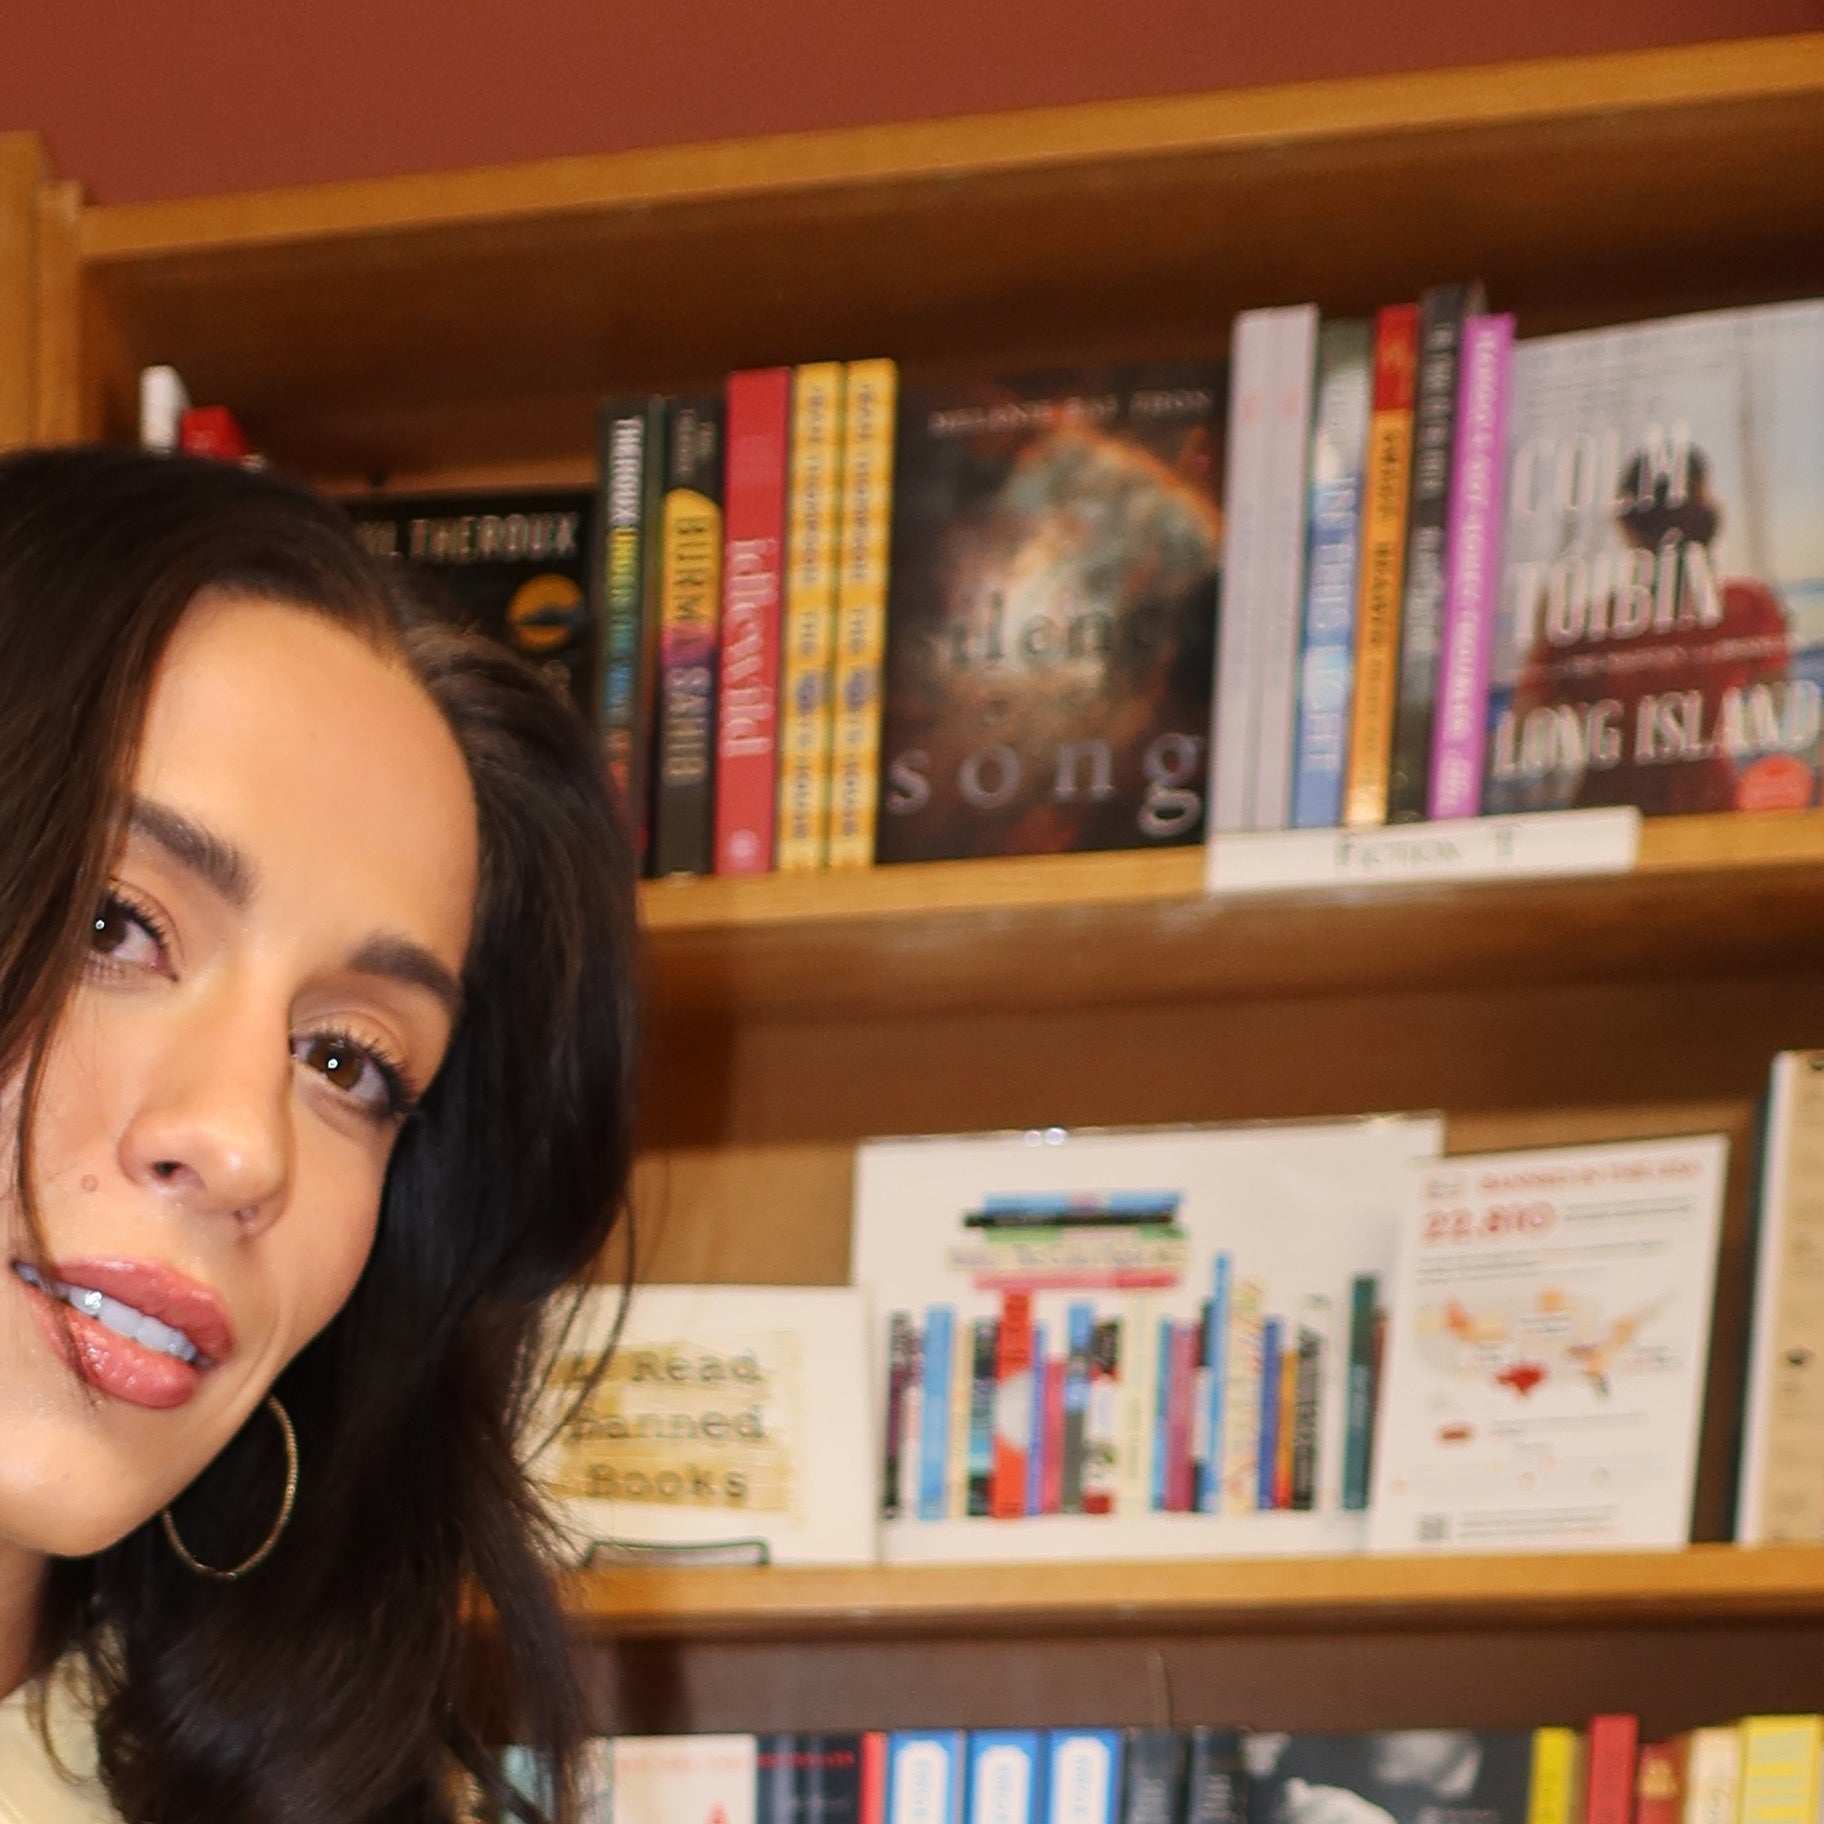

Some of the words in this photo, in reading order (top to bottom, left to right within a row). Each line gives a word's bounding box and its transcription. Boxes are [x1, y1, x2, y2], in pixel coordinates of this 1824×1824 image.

[1493, 698, 1623, 778] LONG
[1634, 680, 1823, 766] ISLAND
[886, 732, 1202, 839] song
[631, 1348, 762, 1384] Read
[584, 1460, 749, 1499] Books
